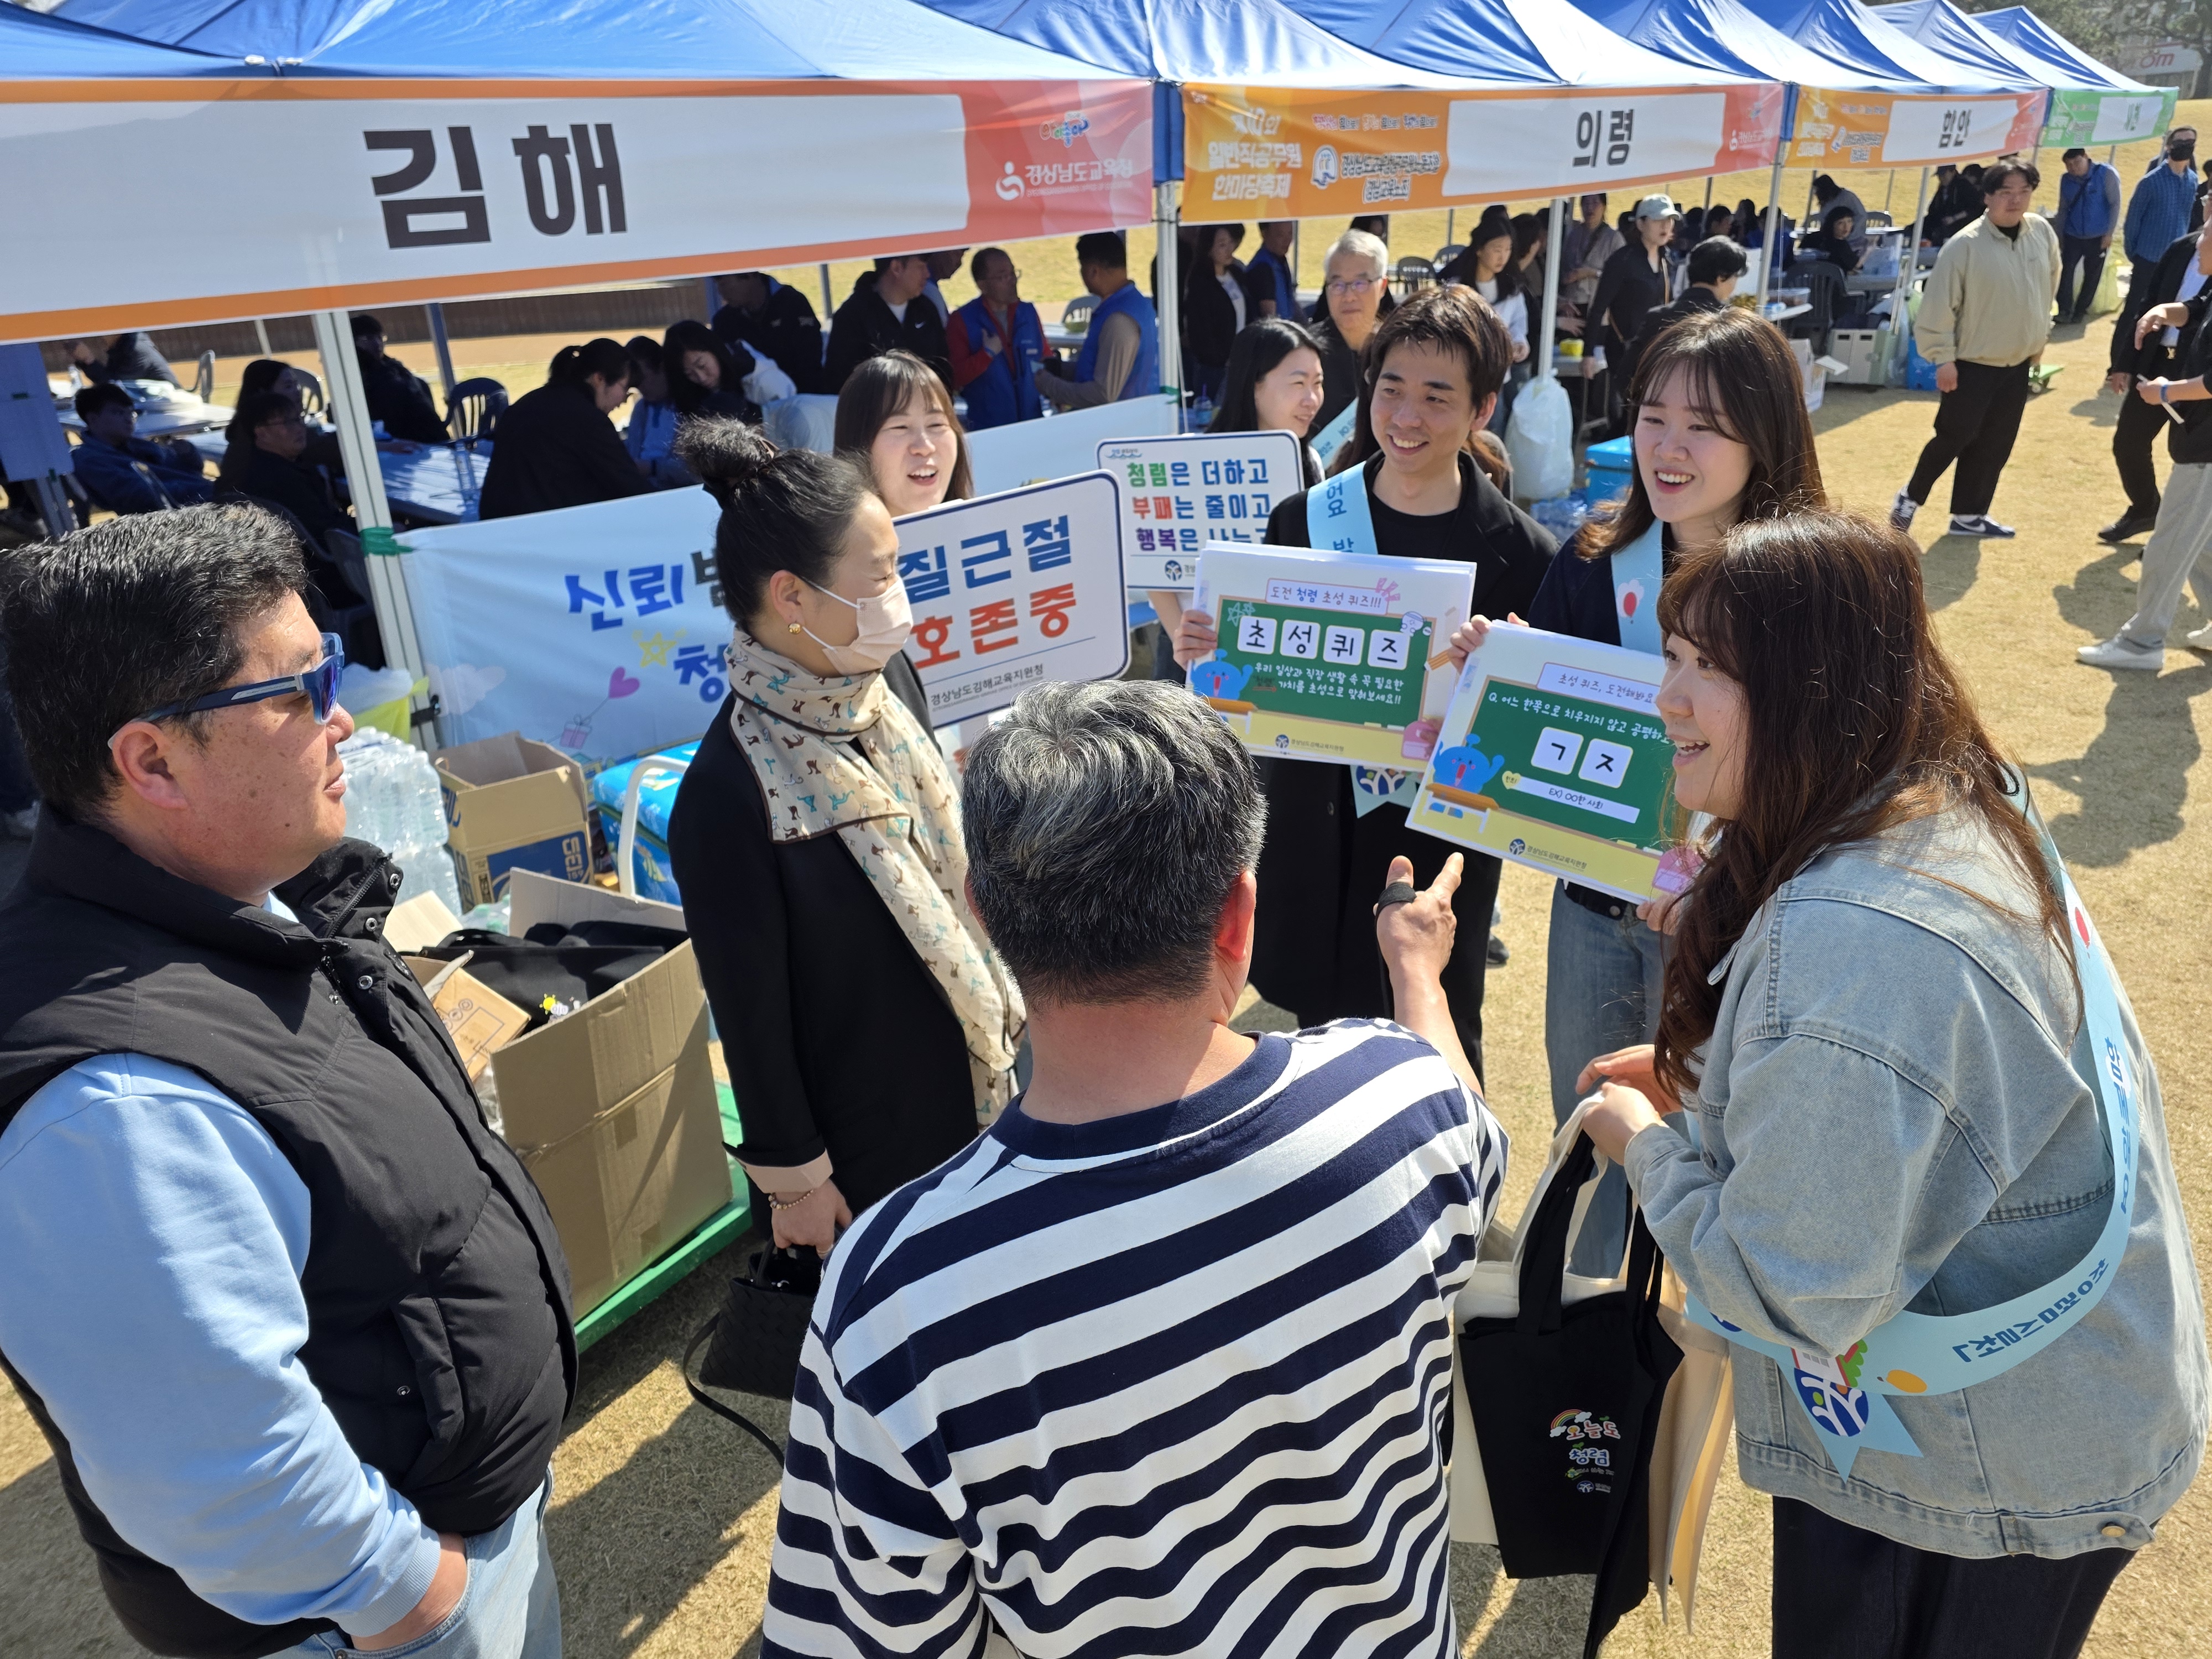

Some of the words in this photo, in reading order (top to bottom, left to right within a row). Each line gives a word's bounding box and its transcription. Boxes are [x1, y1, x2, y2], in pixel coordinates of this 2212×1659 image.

[1572, 109, 1635, 168] 의령
[1939, 109, 1972, 148] 함안
[363, 123, 628, 248] 김해
[1025, 158, 1133, 186] 경상남도교육청
[1126, 461, 1190, 487] 청렴은
[1201, 458, 1269, 485] 더하고
[1132, 495, 1194, 520] 부패는
[1205, 493, 1271, 519] 줄이고
[1135, 527, 1199, 552] 행복은
[565, 564, 685, 632] 신뢰
[1271, 586, 1292, 601] 도전
[1296, 587, 1317, 603] 청렴
[1322, 591, 1344, 606] 초성
[1348, 595, 1382, 608] 퀴즈!!!
[931, 664, 1049, 706] 경상남도김해교육지원청
[1254, 662, 1272, 673] 우리
[1276, 665, 1302, 677] 일상과
[1306, 668, 1324, 681] 직장
[1327, 671, 1346, 685] 생활
[1349, 674, 1358, 685] 속
[1361, 675, 1371, 687] 꼭
[1374, 676, 1404, 692] 필요한
[1278, 680, 1305, 694] 가치를
[1308, 682, 1344, 698] 초성으로
[1558, 673, 1579, 687] 초성
[1580, 679, 1601, 693] 퀴즈,
[1488, 692, 1498, 703] Q.
[1501, 696, 1519, 707] 어느
[1524, 697, 1561, 717] 한쪽으로
[1606, 718, 1627, 733] 않고
[1587, 800, 1603, 810] 사회
[1566, 1420, 1621, 1441] 오늘도
[1569, 1447, 1610, 1467] 청렴
